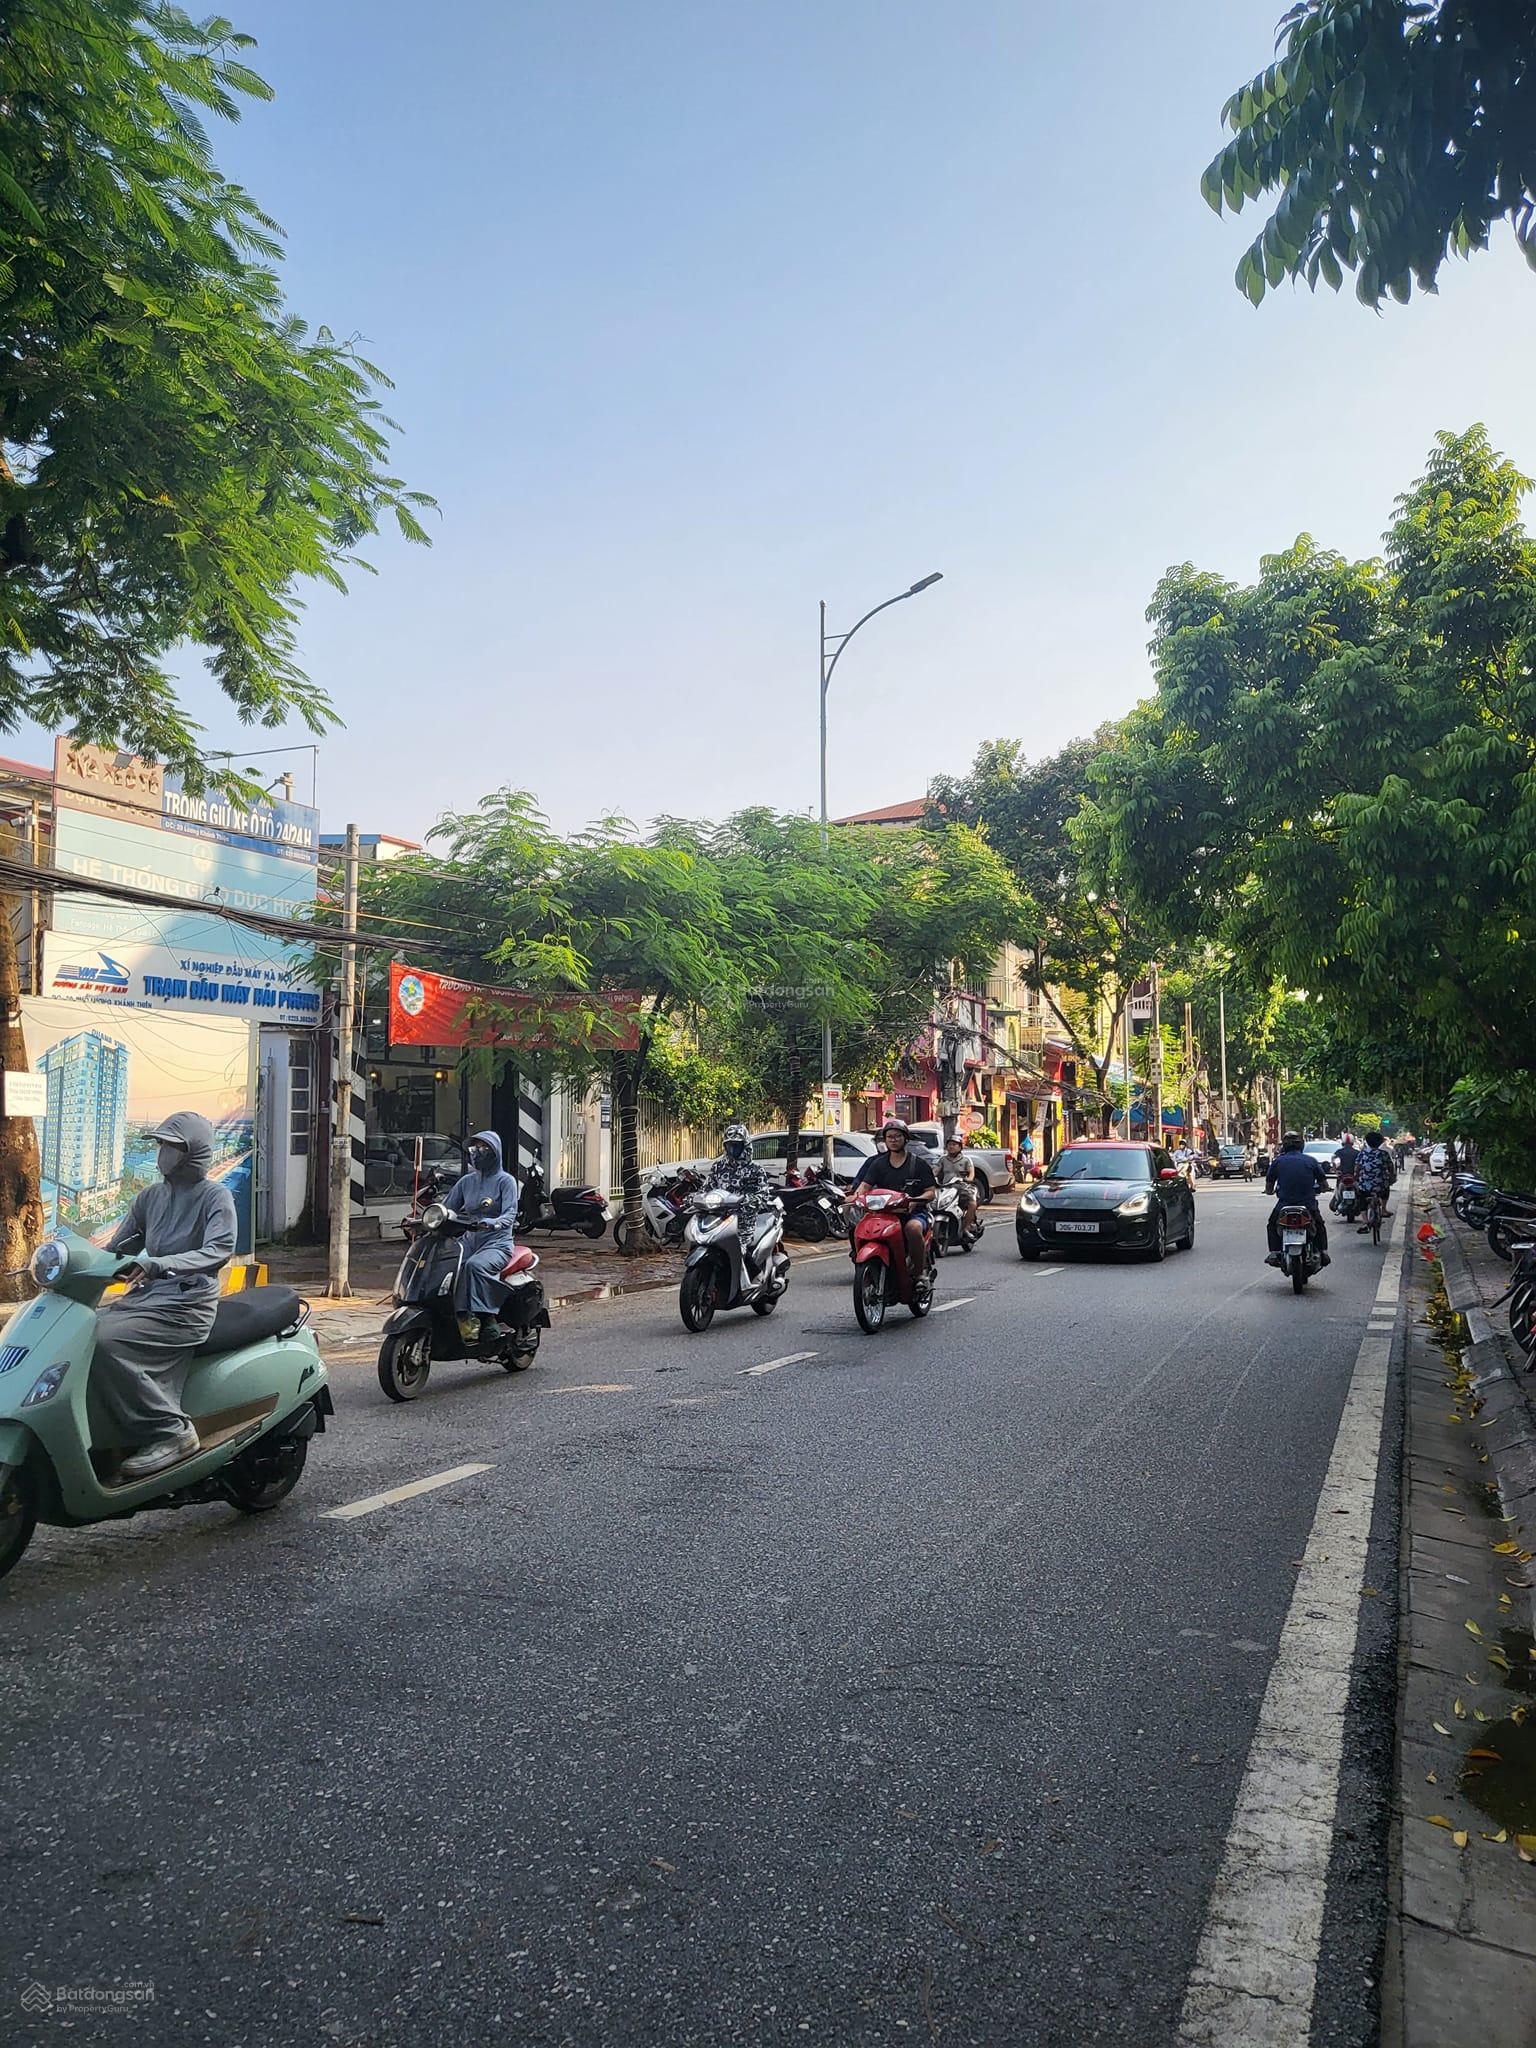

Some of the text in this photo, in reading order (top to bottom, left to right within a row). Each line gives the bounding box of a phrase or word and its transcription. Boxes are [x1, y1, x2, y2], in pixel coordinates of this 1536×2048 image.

[143, 975, 188, 1003] TRẠM
[190, 973, 220, 1001] ĐẦU
[221, 981, 252, 1005] MÁY
[253, 982, 277, 1008] HẢI
